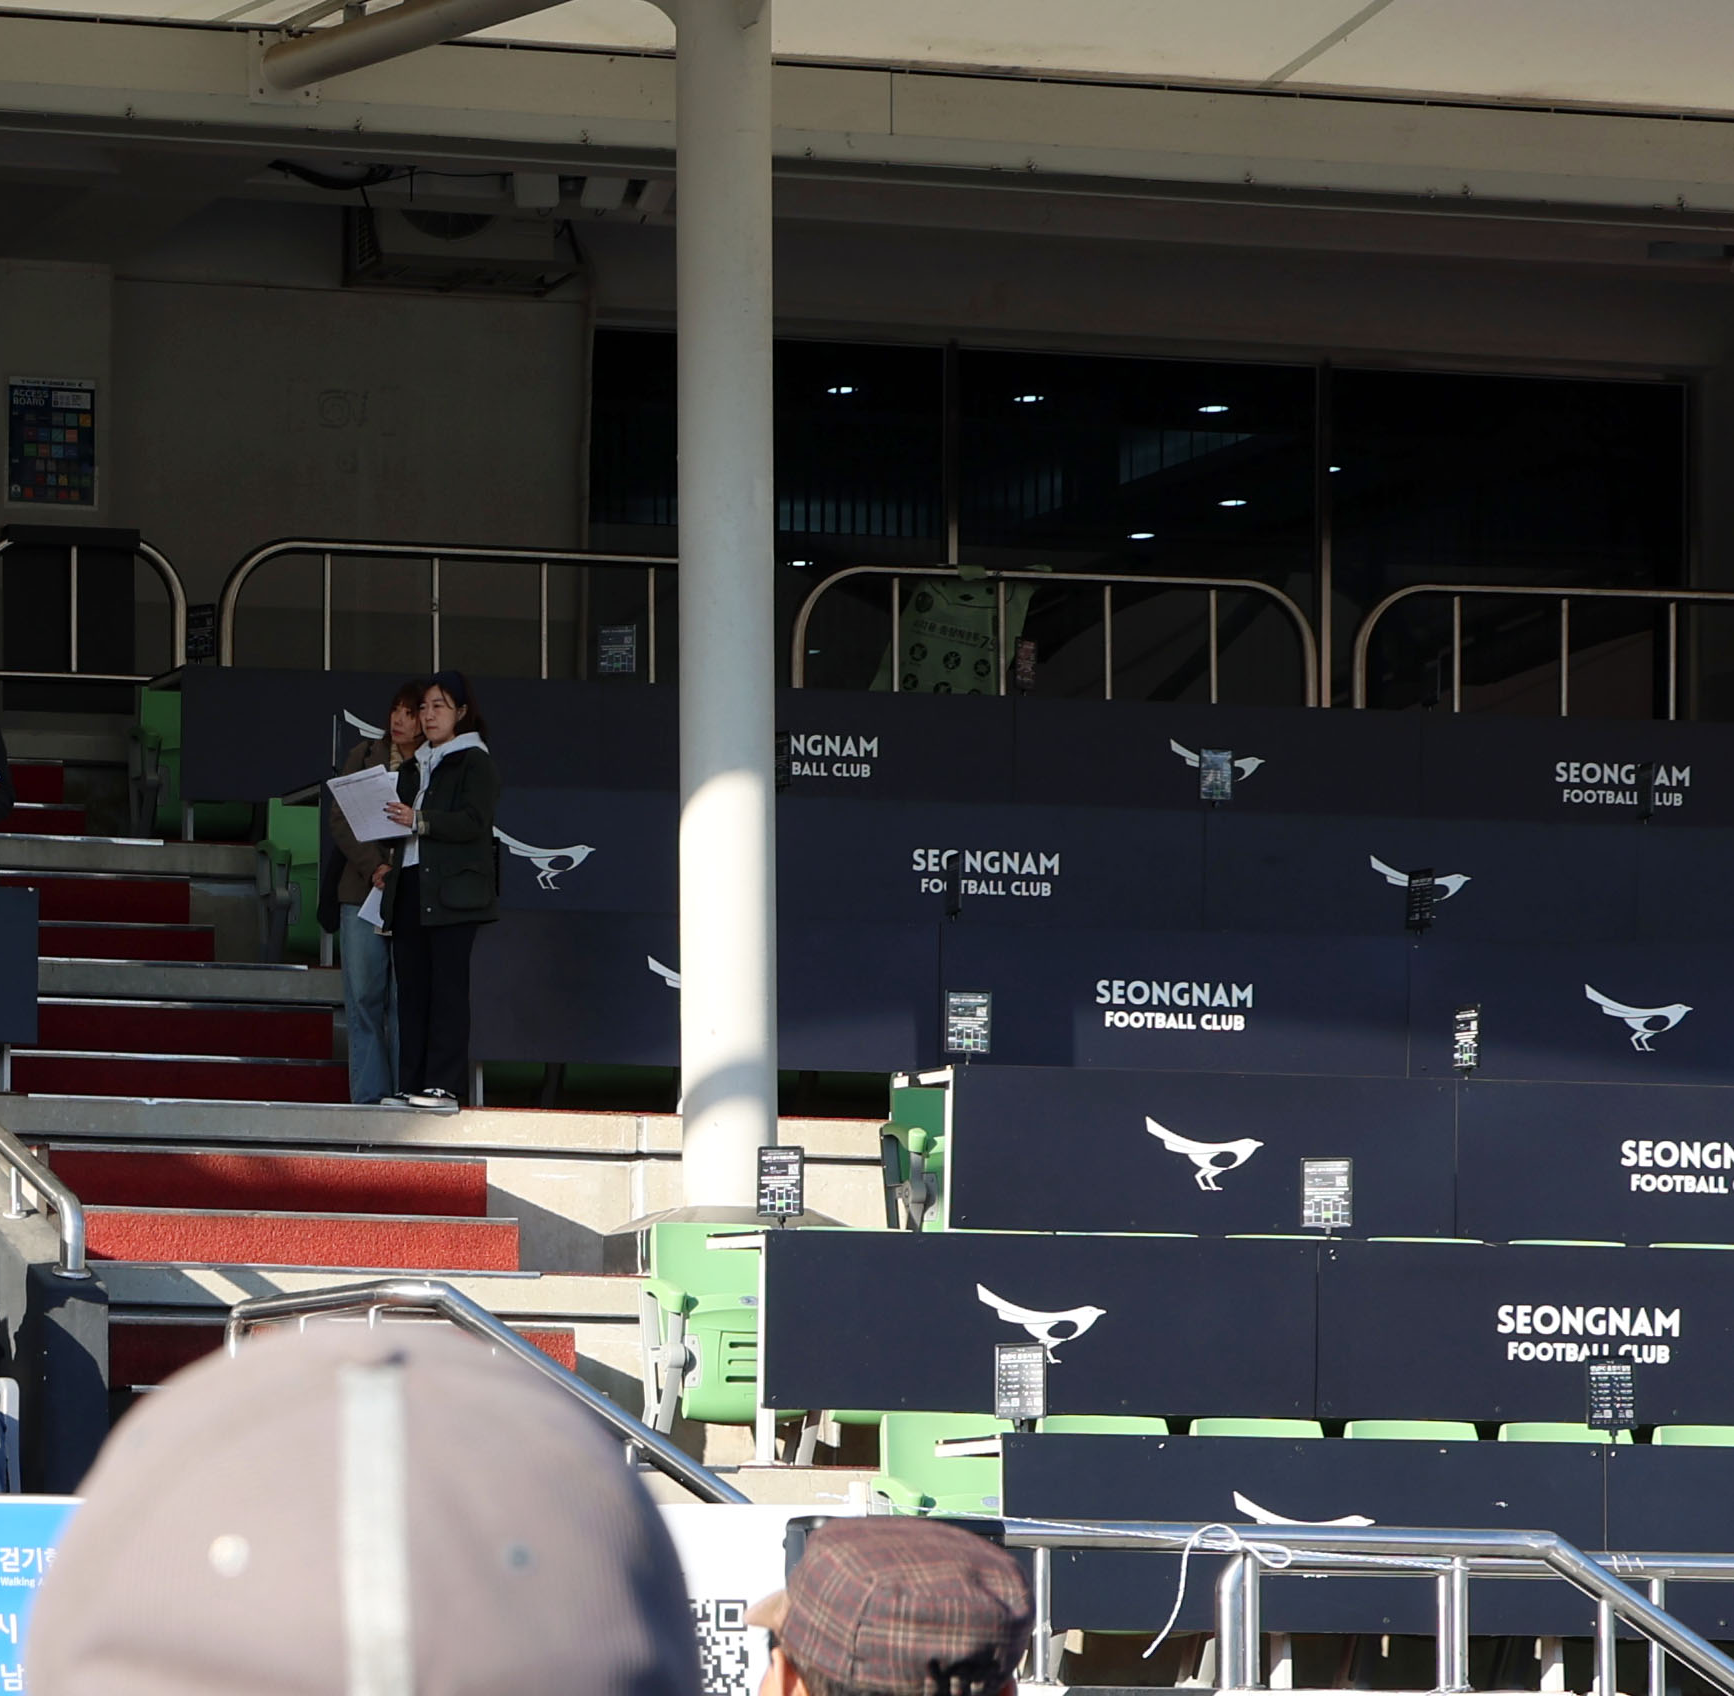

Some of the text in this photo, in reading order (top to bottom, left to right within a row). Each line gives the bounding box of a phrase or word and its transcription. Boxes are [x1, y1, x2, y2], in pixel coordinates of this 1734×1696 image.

[12, 389, 50, 399] ACCESS
[12, 397, 45, 406] BOARD
[790, 734, 879, 758] NGNAM
[791, 761, 871, 778] BALL CLUB
[1555, 761, 1691, 787] SEONGAM
[1654, 791, 1683, 806] LUB
[920, 877, 1052, 897] FOTBALL CLUB
[1095, 979, 1254, 1009] SEONGNAM
[1104, 1010, 1246, 1031] FOOTBALL CLUB
[1620, 1139, 1734, 1170] SEONG
[1630, 1173, 1729, 1194] FOOTBALL
[1497, 1304, 1681, 1338] SEONGNAM
[0, 1576, 36, 1589] Walking
